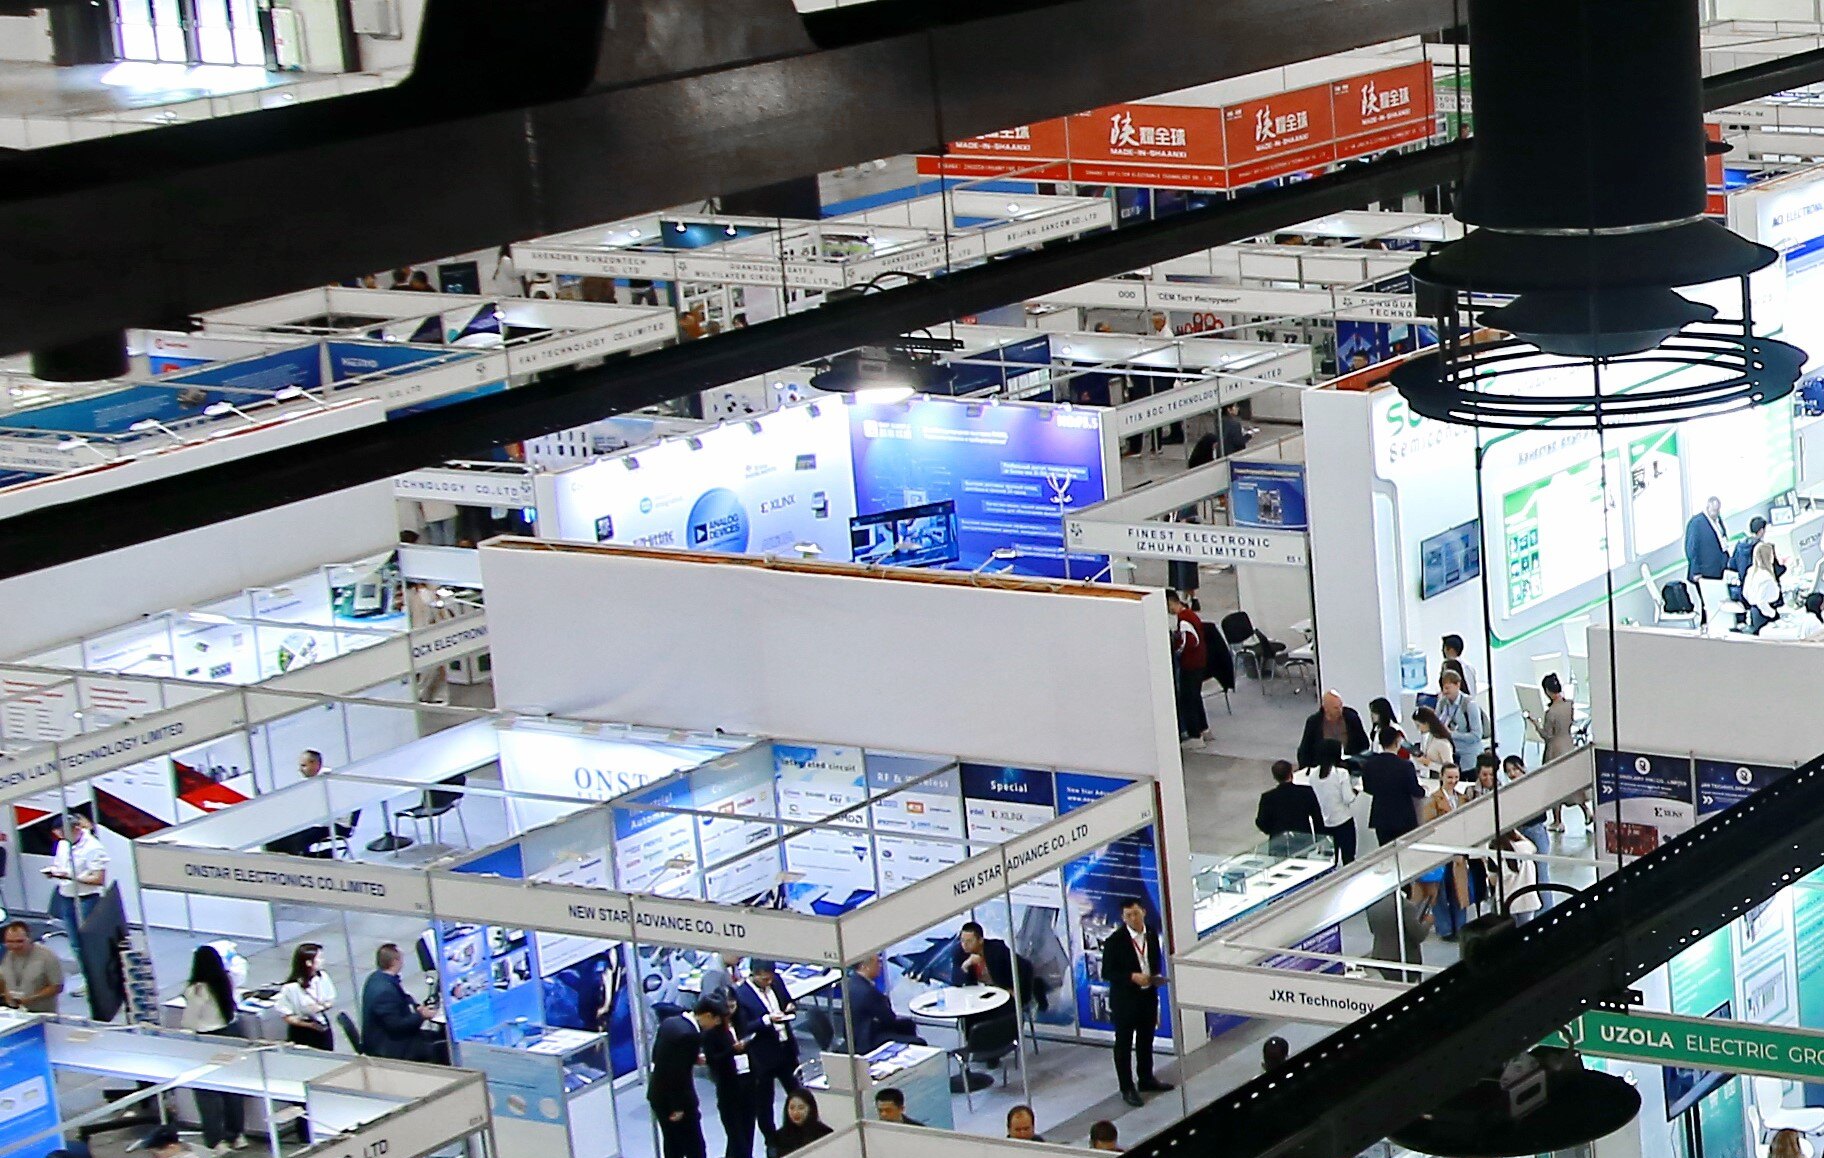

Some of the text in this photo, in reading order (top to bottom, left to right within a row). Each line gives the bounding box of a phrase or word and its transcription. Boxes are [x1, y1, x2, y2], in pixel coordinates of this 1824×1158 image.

[955, 141, 1031, 152] MADE-IN-SHAANXI
[1109, 146, 1188, 158] MADE-IN-SHAANXI
[1254, 133, 1310, 152] MADE-IN-SHAANXI
[1167, 389, 1219, 415] TECHNOLOGY
[708, 512, 739, 530] ANALOG
[709, 523, 741, 541] DEVICES
[1127, 528, 1271, 549] FINEST ELECTRONIC
[1136, 540, 1257, 559] (ZHUHAI) LIMITED
[59, 721, 184, 769] TECHNOLOGY LIMITED
[990, 779, 1028, 795] Special
[953, 874, 976, 896] NEW
[976, 863, 1003, 886] STAR
[1005, 839, 1051, 873] ADVANCE
[1071, 823, 1089, 843] LTD
[183, 862, 315, 891] ONSTAR ELECTRONICS
[568, 903, 596, 921] NEW
[598, 907, 631, 925] STAR
[635, 911, 693, 933] ADVANCE
[722, 922, 746, 939] LTD
[1269, 987, 1375, 1015] JXR Technology
[1600, 1023, 1675, 1050] UZOLA
[1686, 1034, 1779, 1061] ELECTRIC
